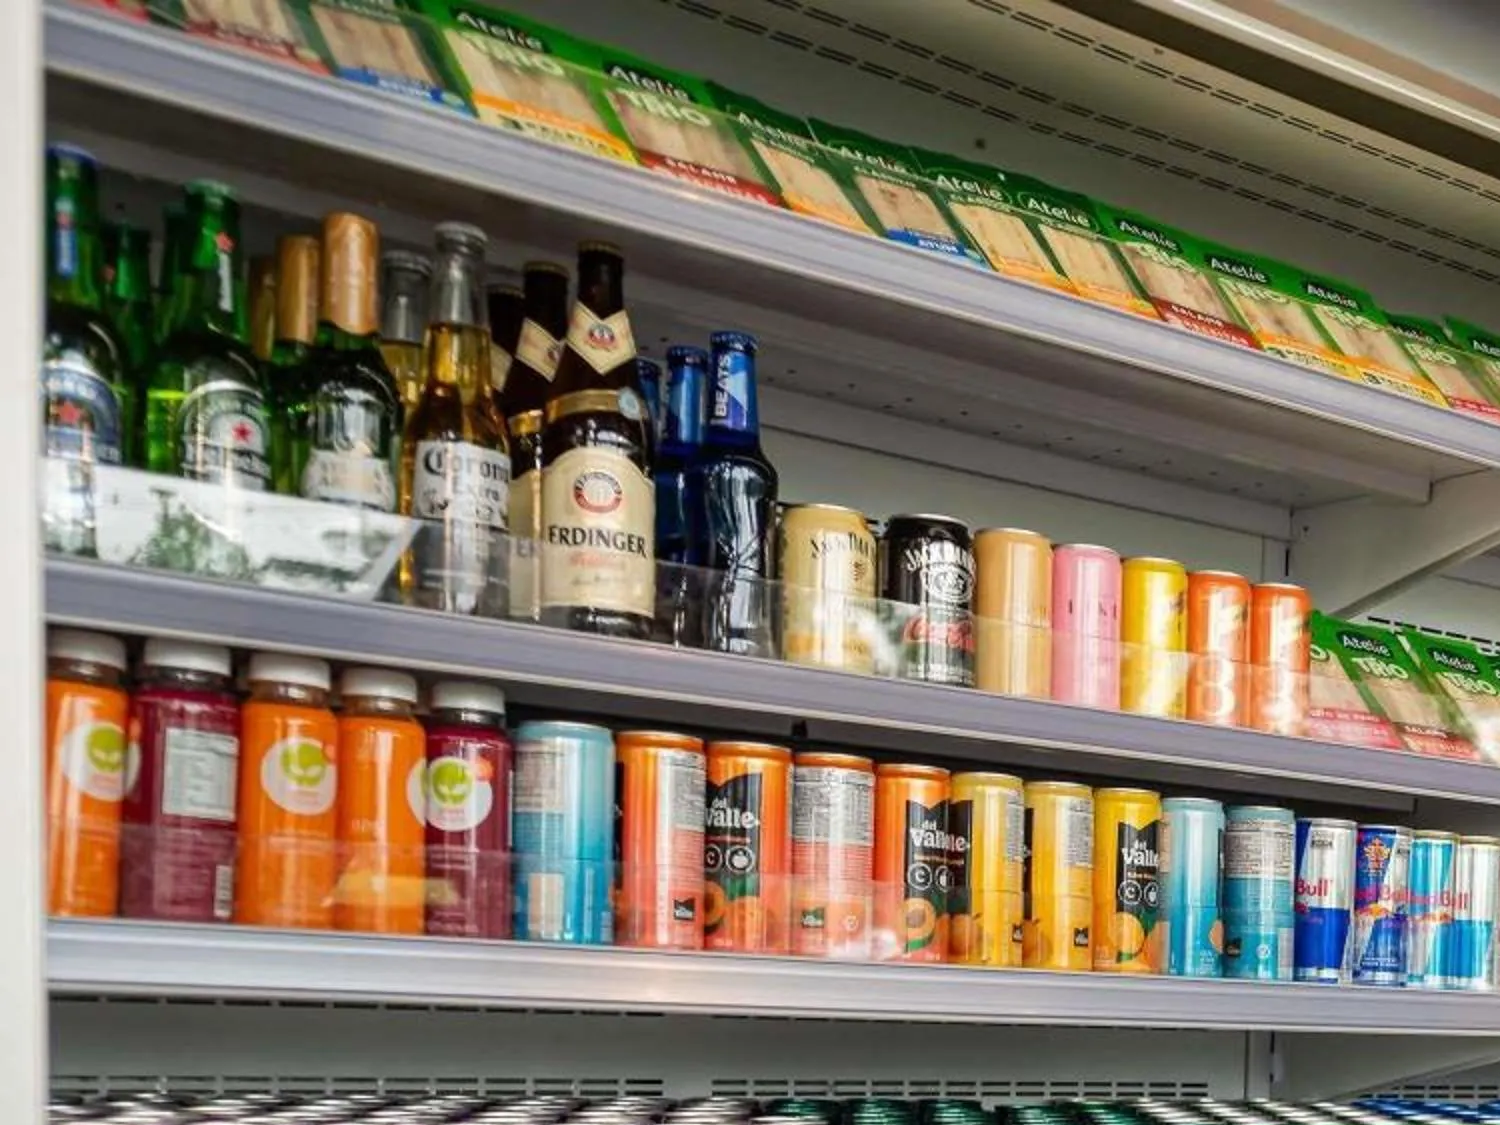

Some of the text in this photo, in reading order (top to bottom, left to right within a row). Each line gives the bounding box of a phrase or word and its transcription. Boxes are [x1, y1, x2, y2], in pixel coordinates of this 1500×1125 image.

[936, 174, 1003, 201] Atelie
[1027, 198, 1090, 227] Atelie
[713, 353, 733, 416] BEATS
[548, 524, 648, 559] ERDINGER
